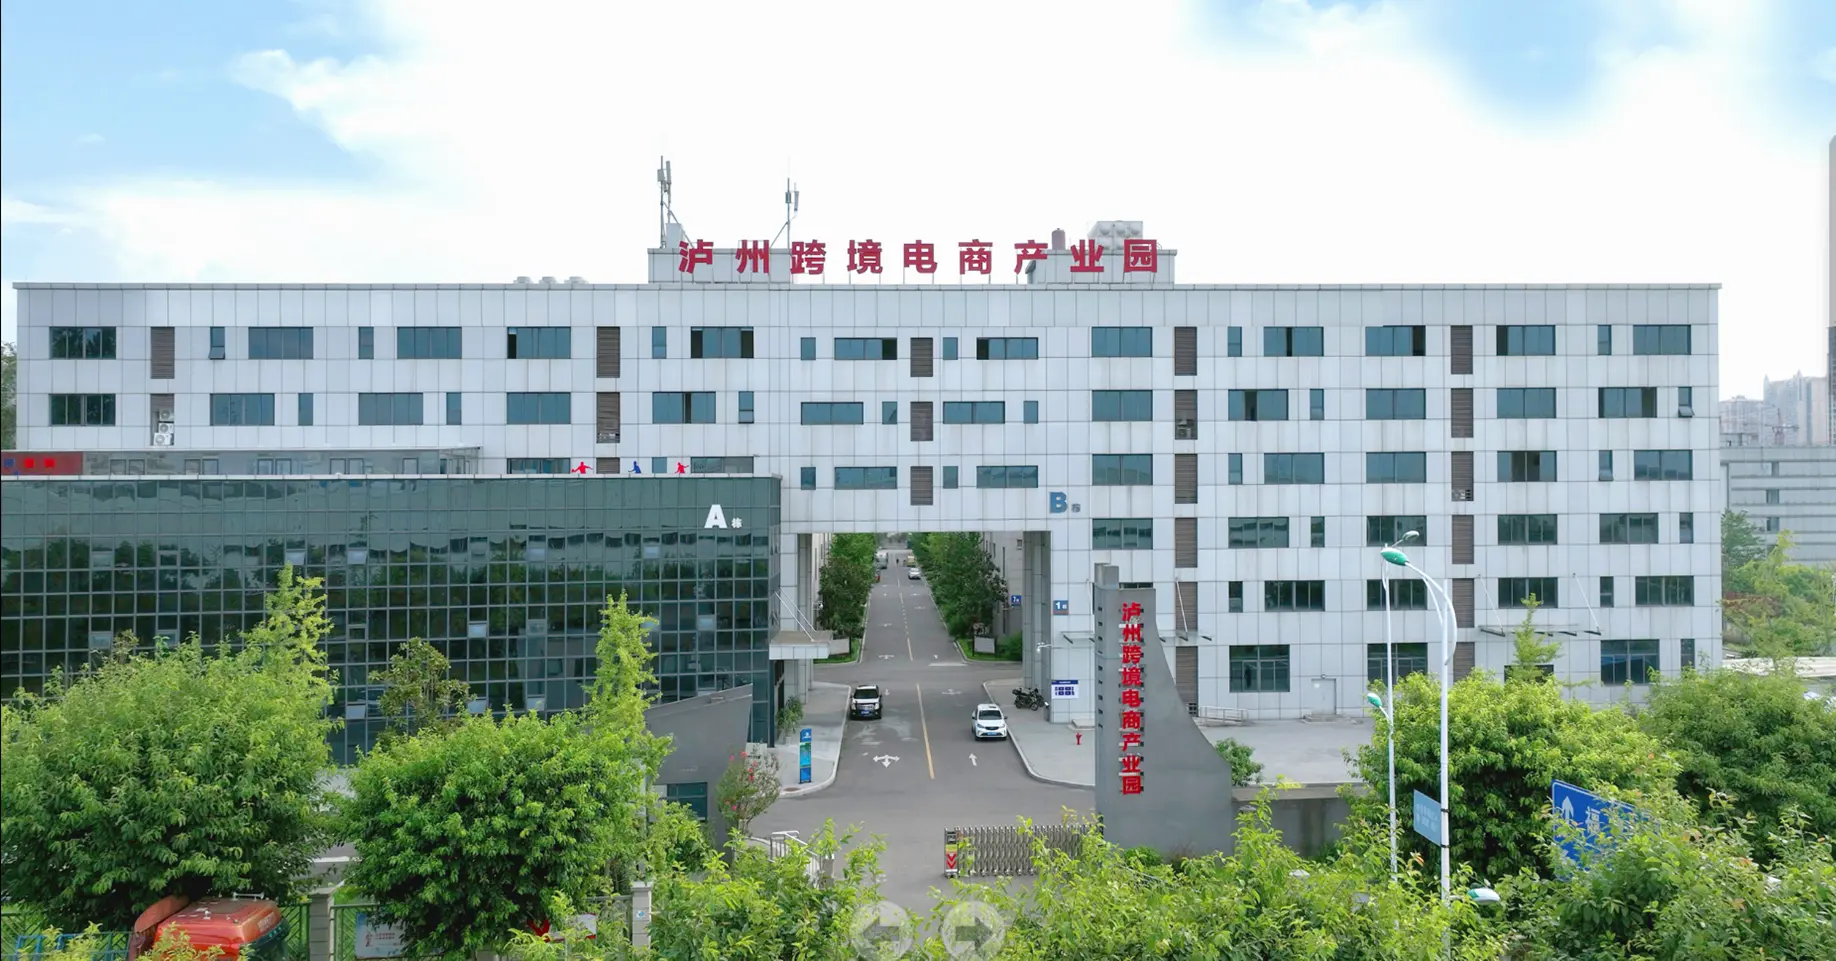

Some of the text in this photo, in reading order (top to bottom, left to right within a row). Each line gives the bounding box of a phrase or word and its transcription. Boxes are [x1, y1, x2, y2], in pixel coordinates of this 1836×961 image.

[679, 239, 1158, 275] 泸州跨境电商产业园
[1121, 601, 1143, 796] 泸州跨境电商产业园
